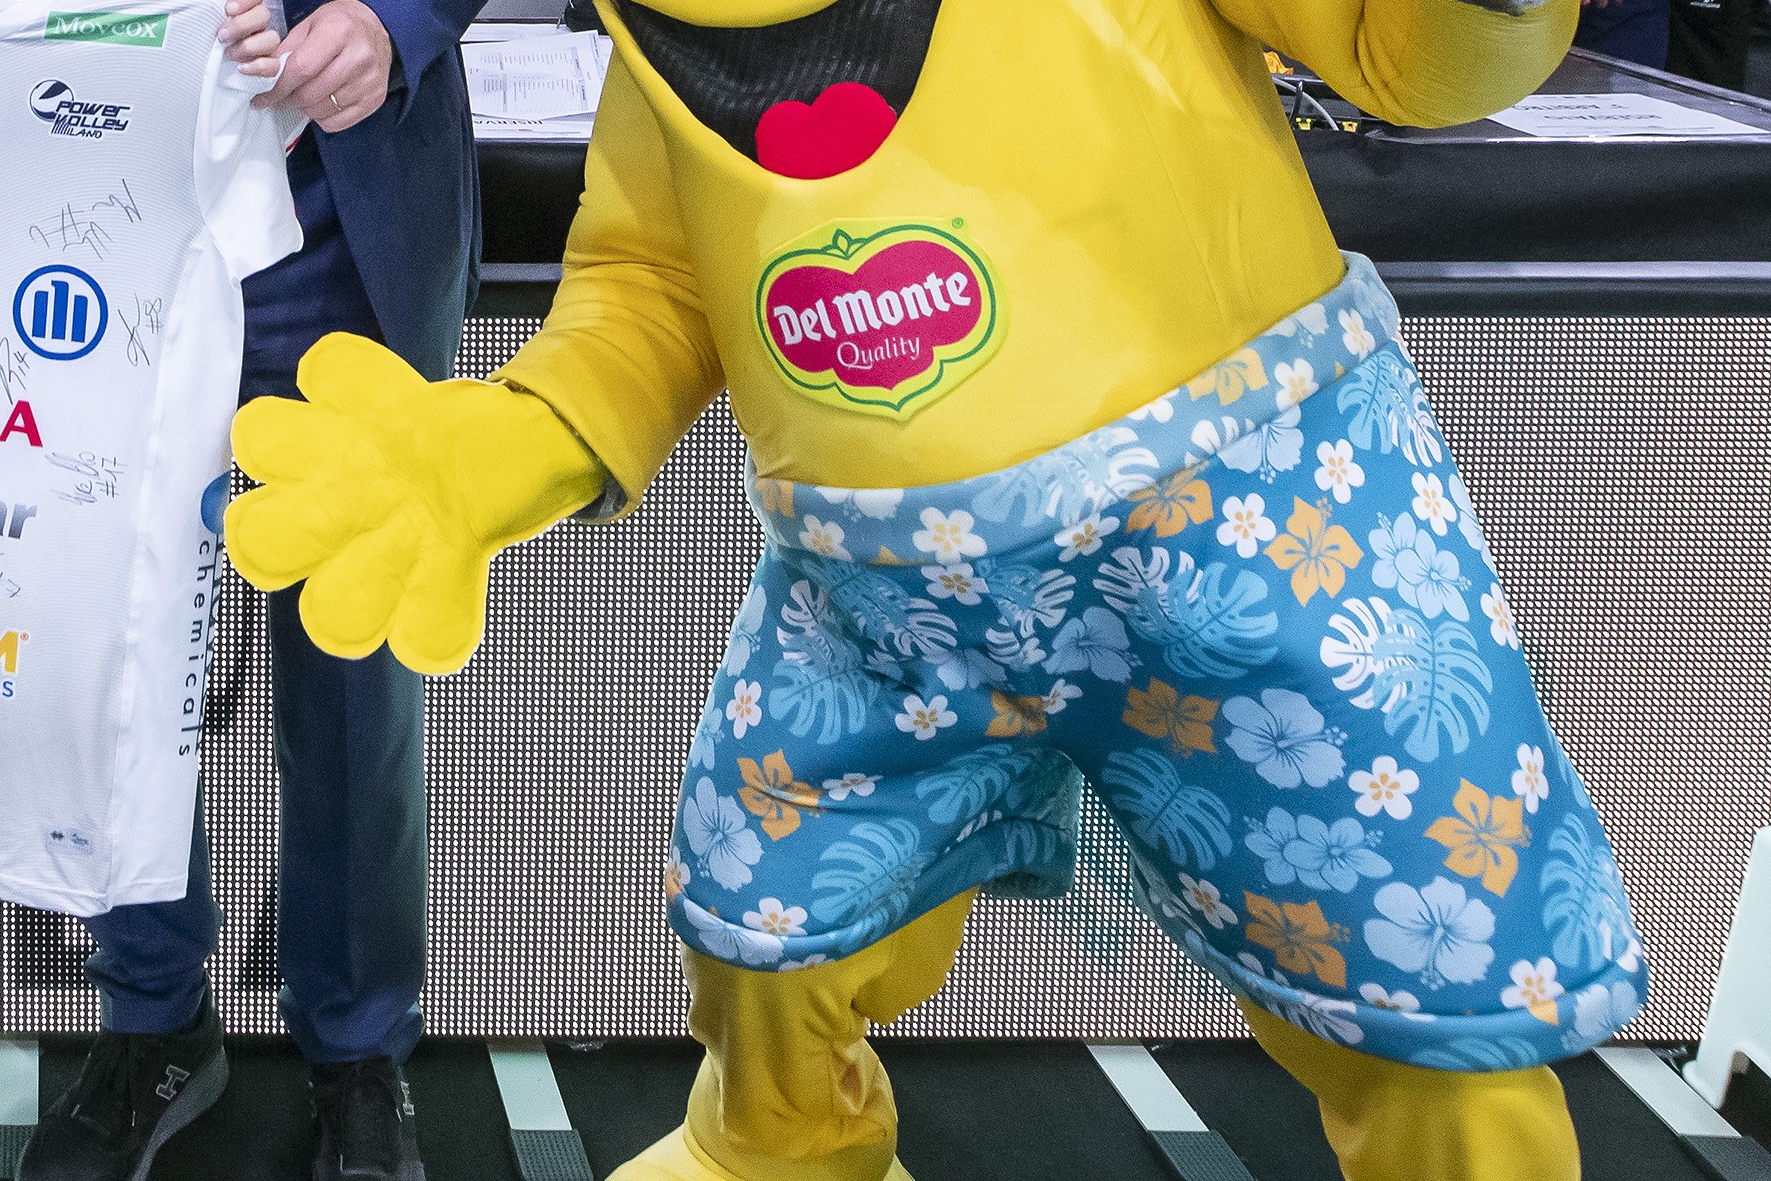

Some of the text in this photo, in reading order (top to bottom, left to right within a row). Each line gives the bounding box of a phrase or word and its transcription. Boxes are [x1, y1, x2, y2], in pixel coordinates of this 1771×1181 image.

[773, 271, 972, 346] Del Monte
[836, 337, 921, 370] Quality
[178, 539, 218, 757] chemicals
